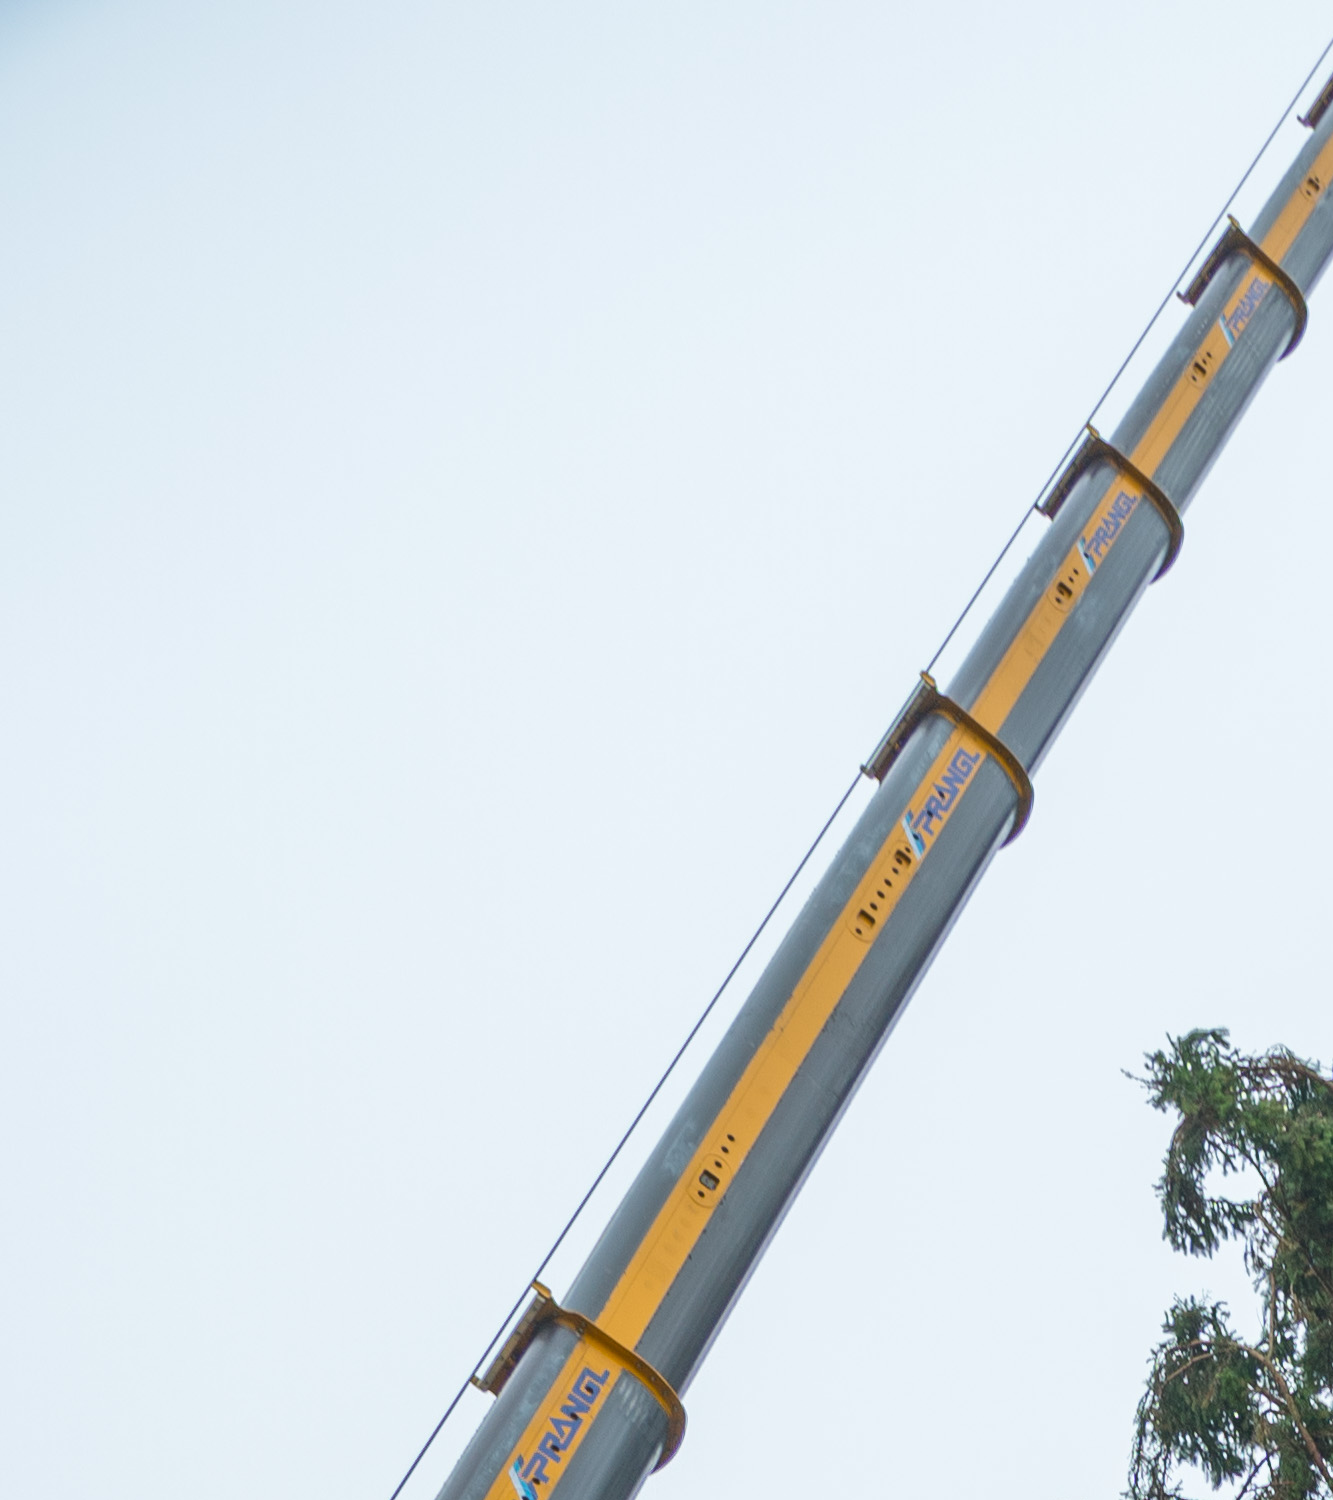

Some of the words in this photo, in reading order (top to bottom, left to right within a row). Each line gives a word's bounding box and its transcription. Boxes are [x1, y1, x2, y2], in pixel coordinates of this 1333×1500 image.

[1087, 490, 1137, 557] PRANGL
[912, 747, 980, 836] PRANGL
[522, 1367, 610, 1485] PRANGL
